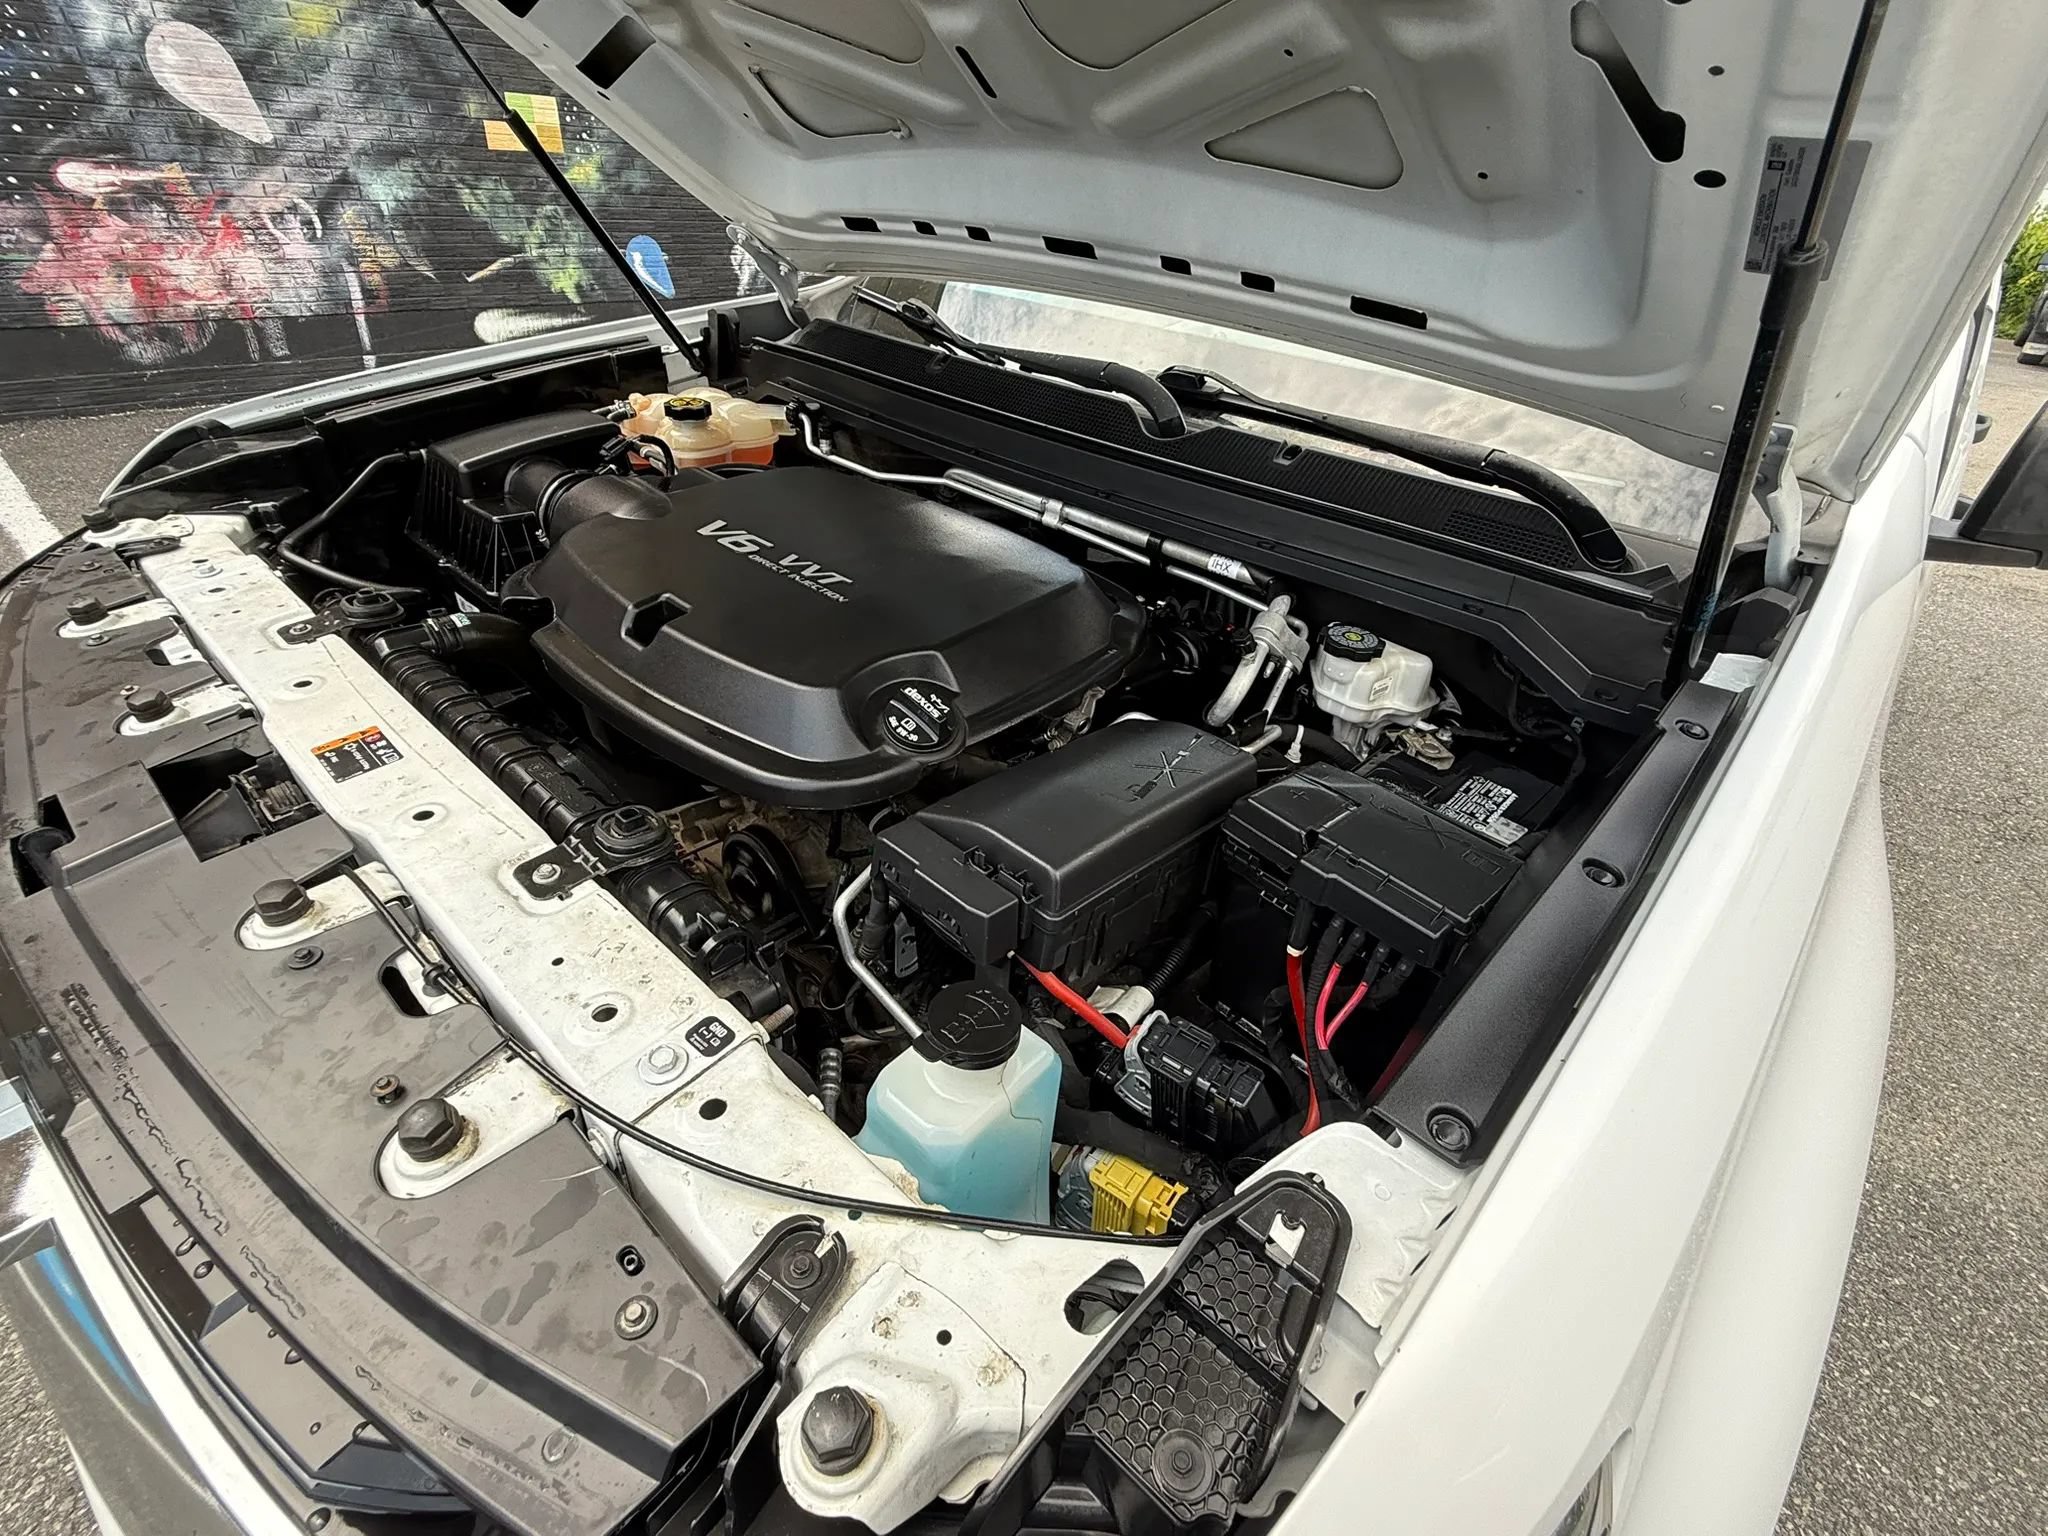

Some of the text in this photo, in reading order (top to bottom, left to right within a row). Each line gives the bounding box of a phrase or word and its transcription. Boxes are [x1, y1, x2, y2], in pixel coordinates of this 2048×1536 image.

[697, 519, 853, 584] V6 VVT
[748, 554, 849, 602] DIRECT INJECTION
[903, 686, 942, 719] dexos
[708, 1021, 728, 1038] GND
